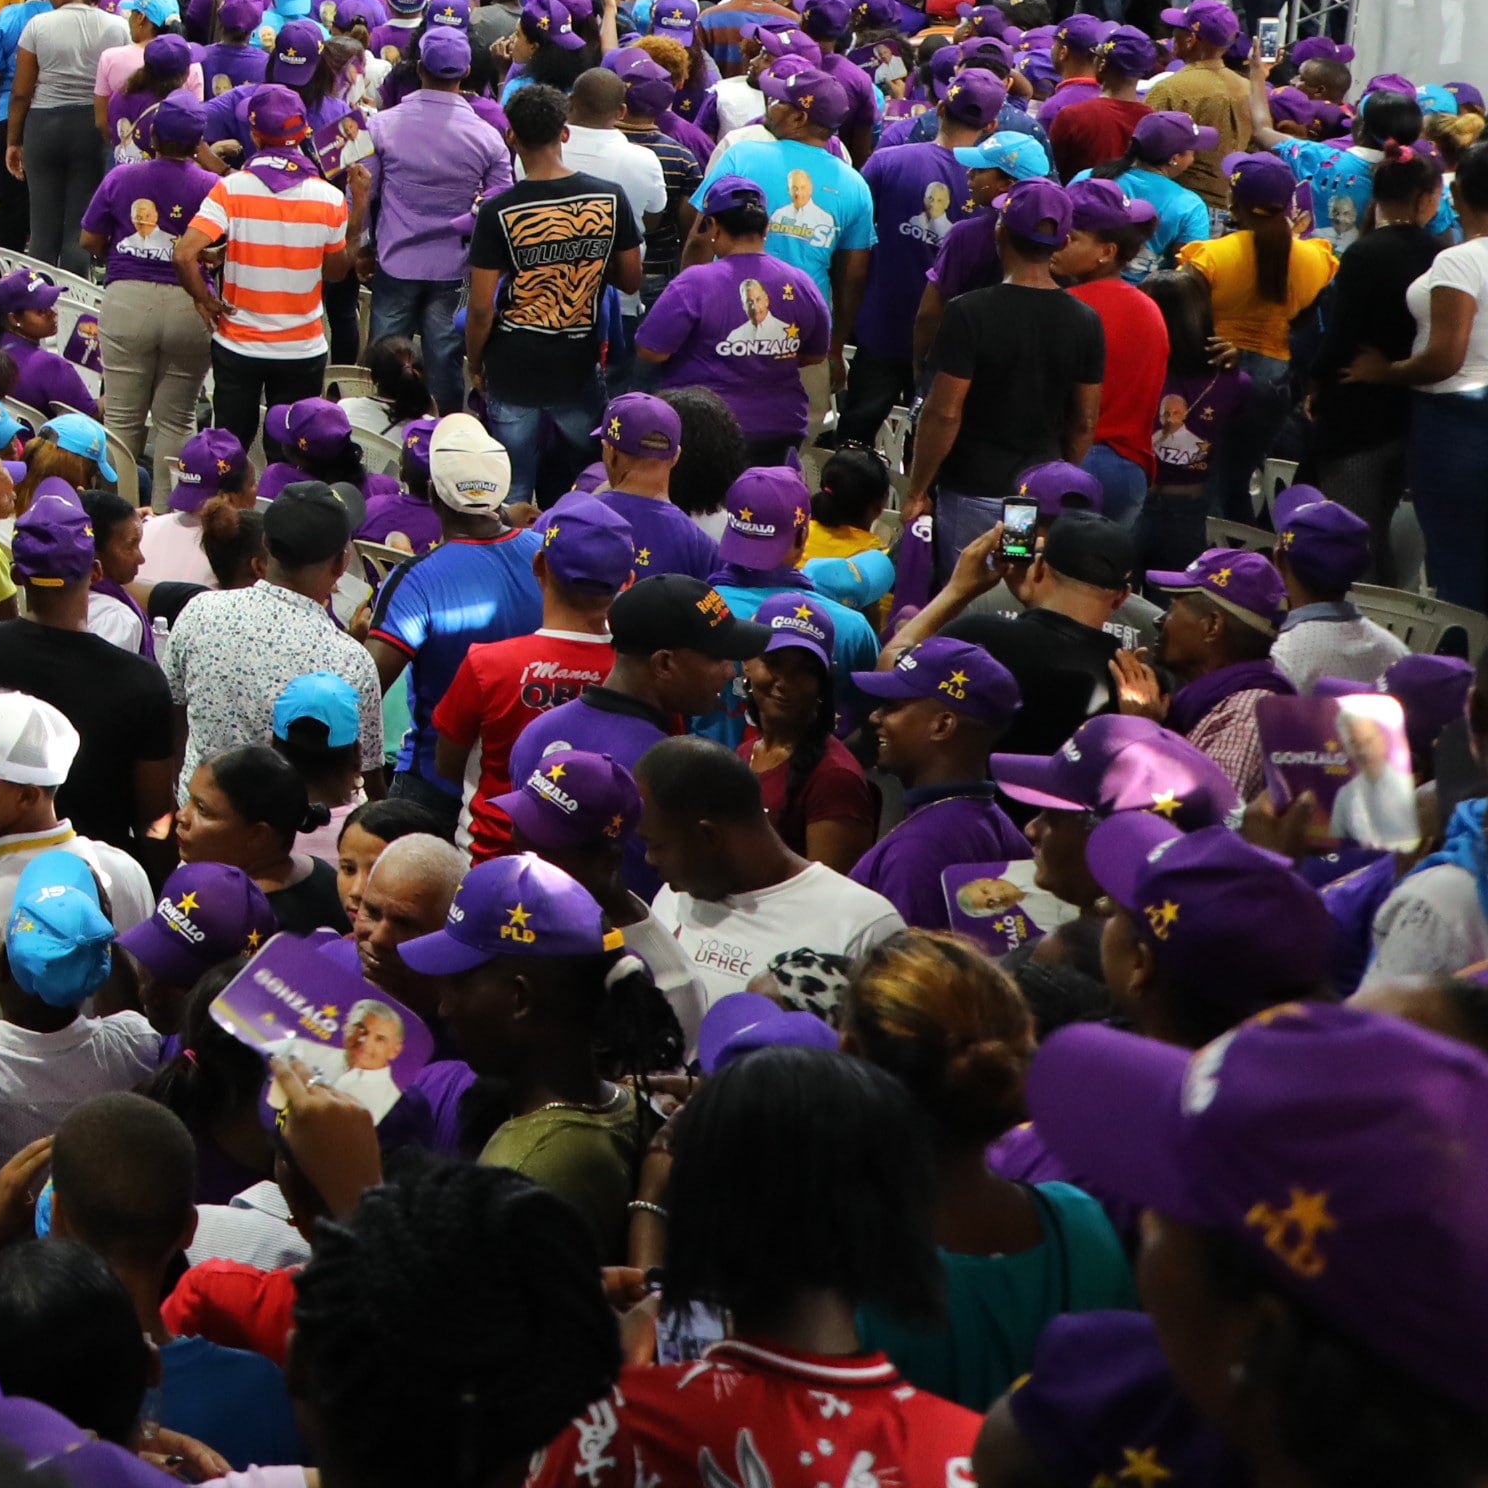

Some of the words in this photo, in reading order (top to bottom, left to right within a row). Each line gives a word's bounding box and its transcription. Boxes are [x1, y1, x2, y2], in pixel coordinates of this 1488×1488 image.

[715, 339, 801, 357] GONZALO
[771, 616, 825, 640] GONZALO
[938, 680, 966, 700] PLD
[527, 770, 579, 813] GONZALO
[156, 897, 206, 944] GONZALO
[500, 924, 536, 943] PLD
[700, 938, 718, 952] YO
[720, 942, 754, 961] SOY
[694, 950, 753, 977] UFHEC
